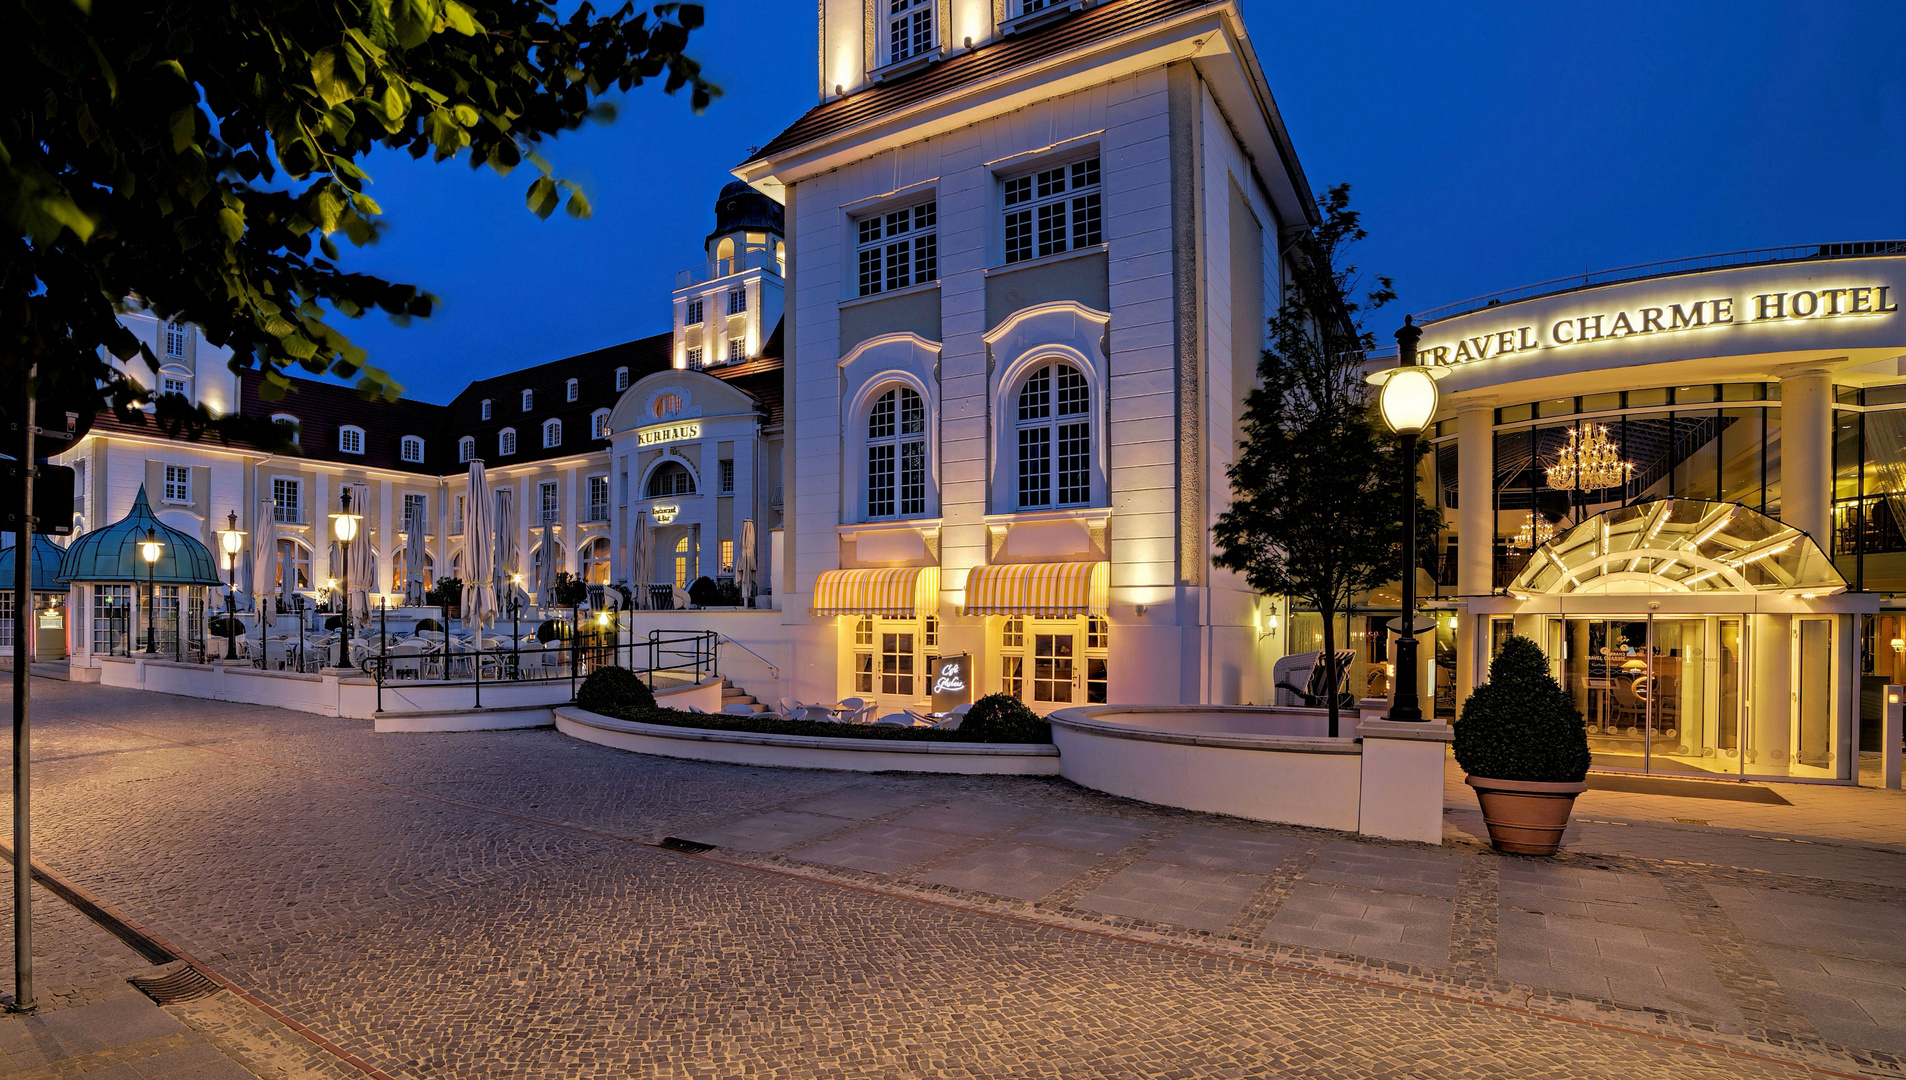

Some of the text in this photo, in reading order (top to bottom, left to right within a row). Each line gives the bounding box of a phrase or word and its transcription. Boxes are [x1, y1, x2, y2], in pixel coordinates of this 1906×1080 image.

[1417, 286, 1898, 366] TRAVEL CHARME HOTEL
[637, 425, 698, 445] KURHAUS
